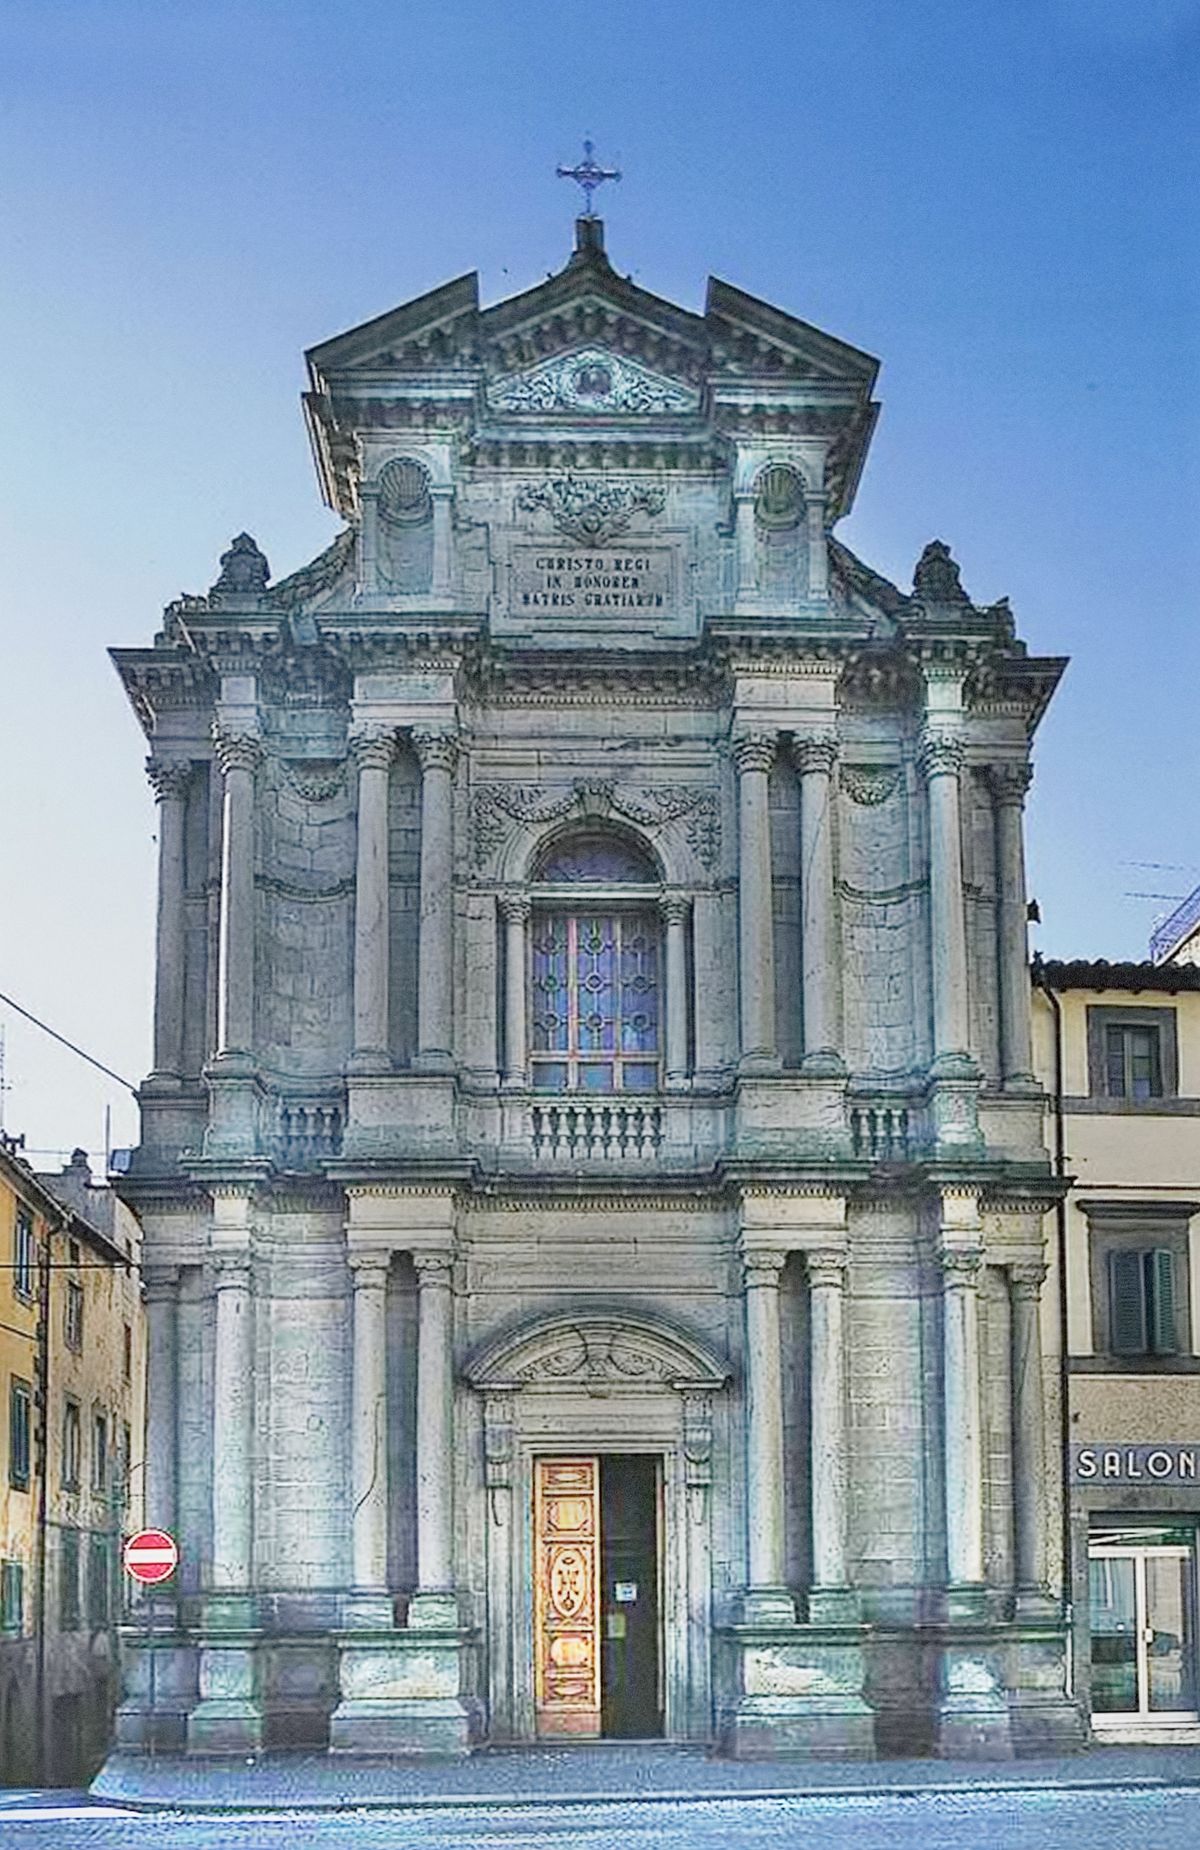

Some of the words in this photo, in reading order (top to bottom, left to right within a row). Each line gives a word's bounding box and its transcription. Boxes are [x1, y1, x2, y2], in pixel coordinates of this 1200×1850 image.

[614, 558, 650, 571] REGI
[547, 575, 562, 588] IN
[1078, 1449, 1195, 1478] SALON
